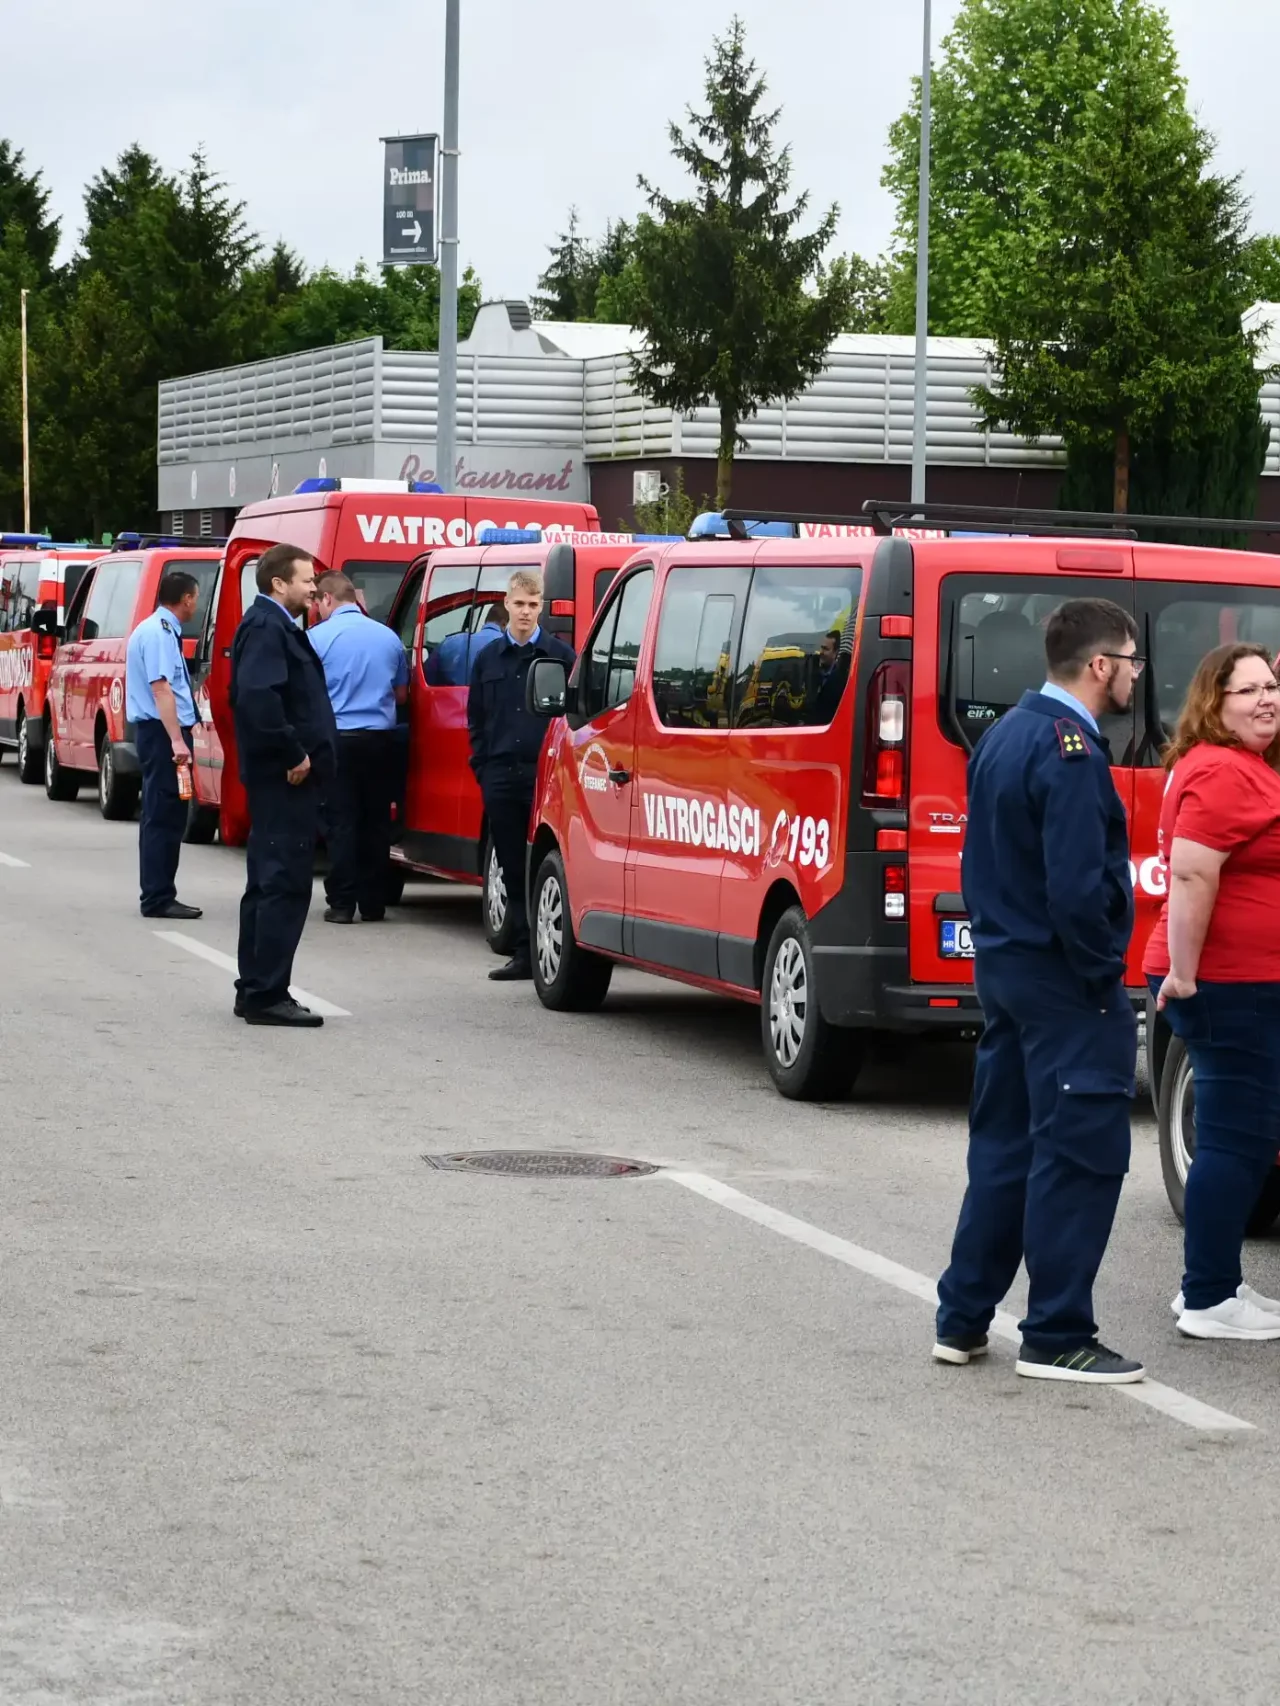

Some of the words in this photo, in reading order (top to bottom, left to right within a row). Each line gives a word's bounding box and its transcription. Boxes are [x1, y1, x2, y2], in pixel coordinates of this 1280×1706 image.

[399, 453, 574, 492] Retaurant
[544, 531, 632, 545] VATROGASCI
[804, 523, 946, 539] VATROASCI
[967, 709, 986, 718] elf
[928, 812, 968, 825] TRA
[643, 792, 760, 857] VATROGASCI
[788, 815, 829, 869] 193
